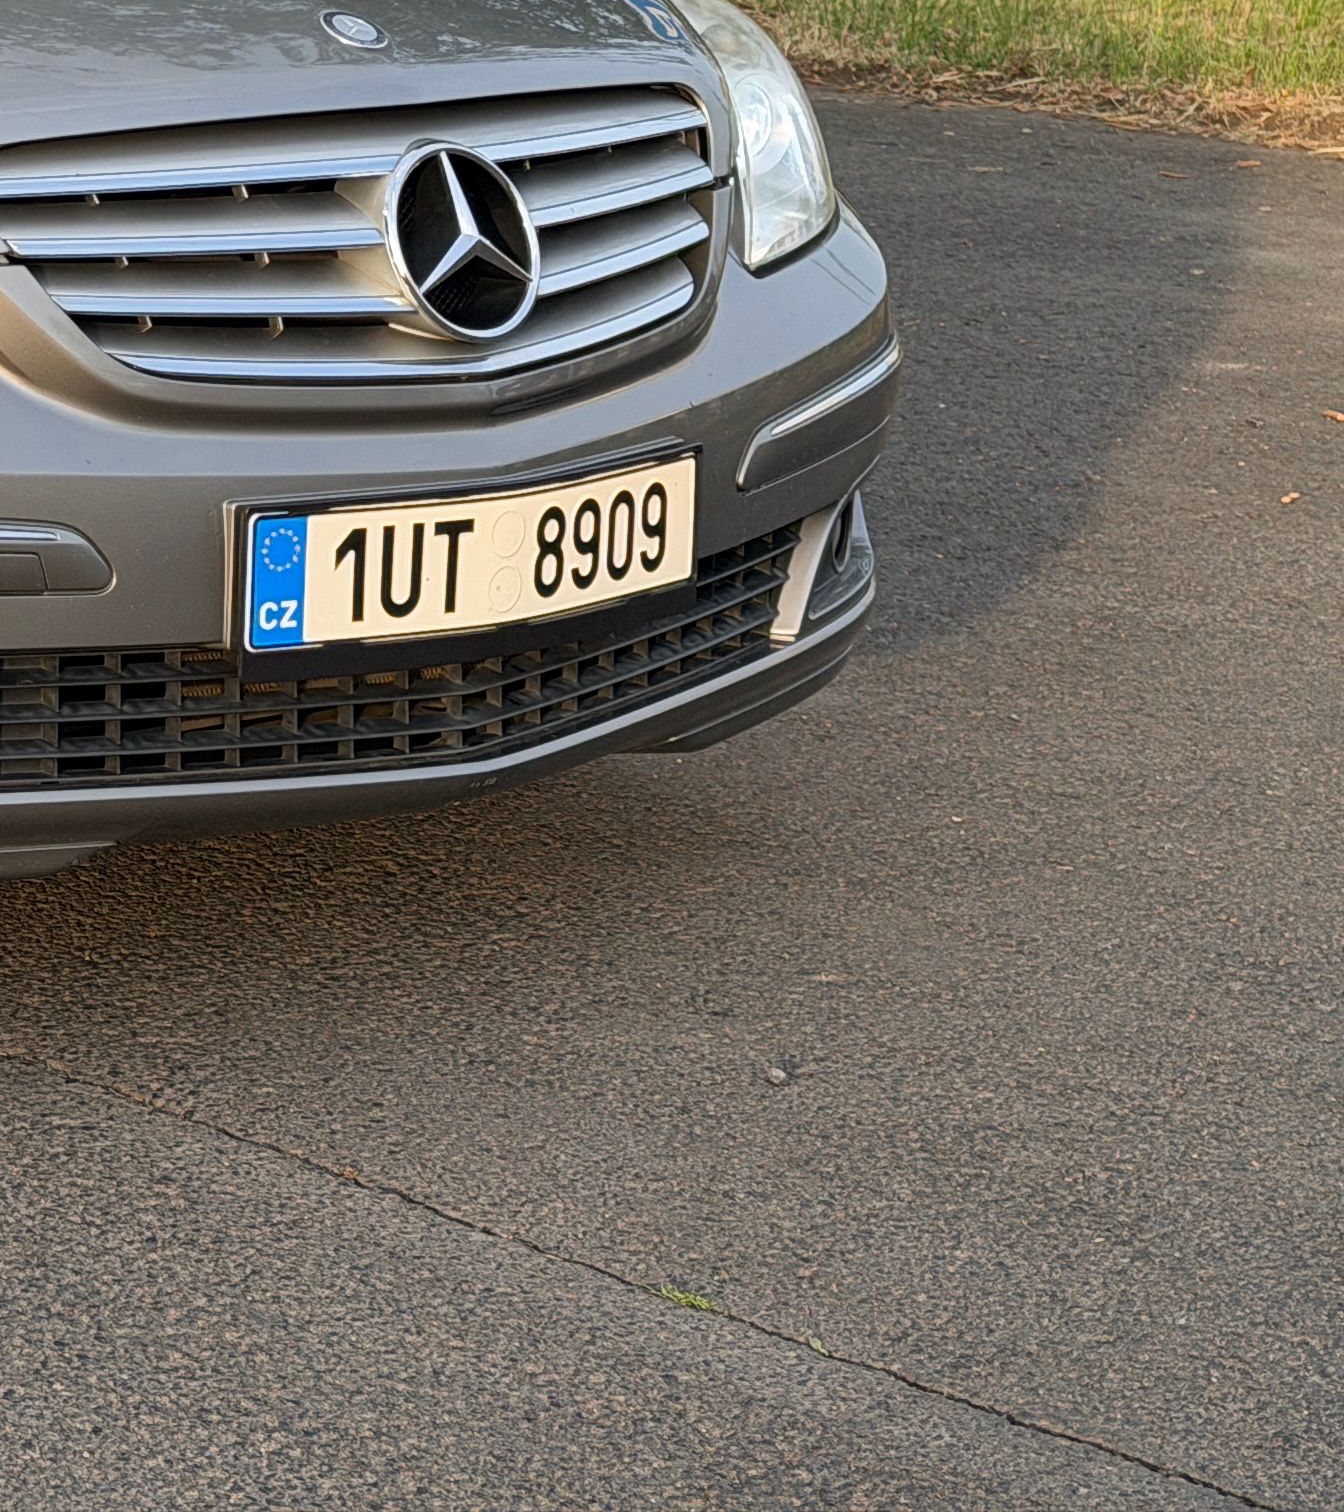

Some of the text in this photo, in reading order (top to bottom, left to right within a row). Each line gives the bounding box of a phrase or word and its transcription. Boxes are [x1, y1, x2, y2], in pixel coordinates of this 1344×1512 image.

[333, 481, 668, 623] 1UT 8909
[258, 599, 298, 631] CZ
